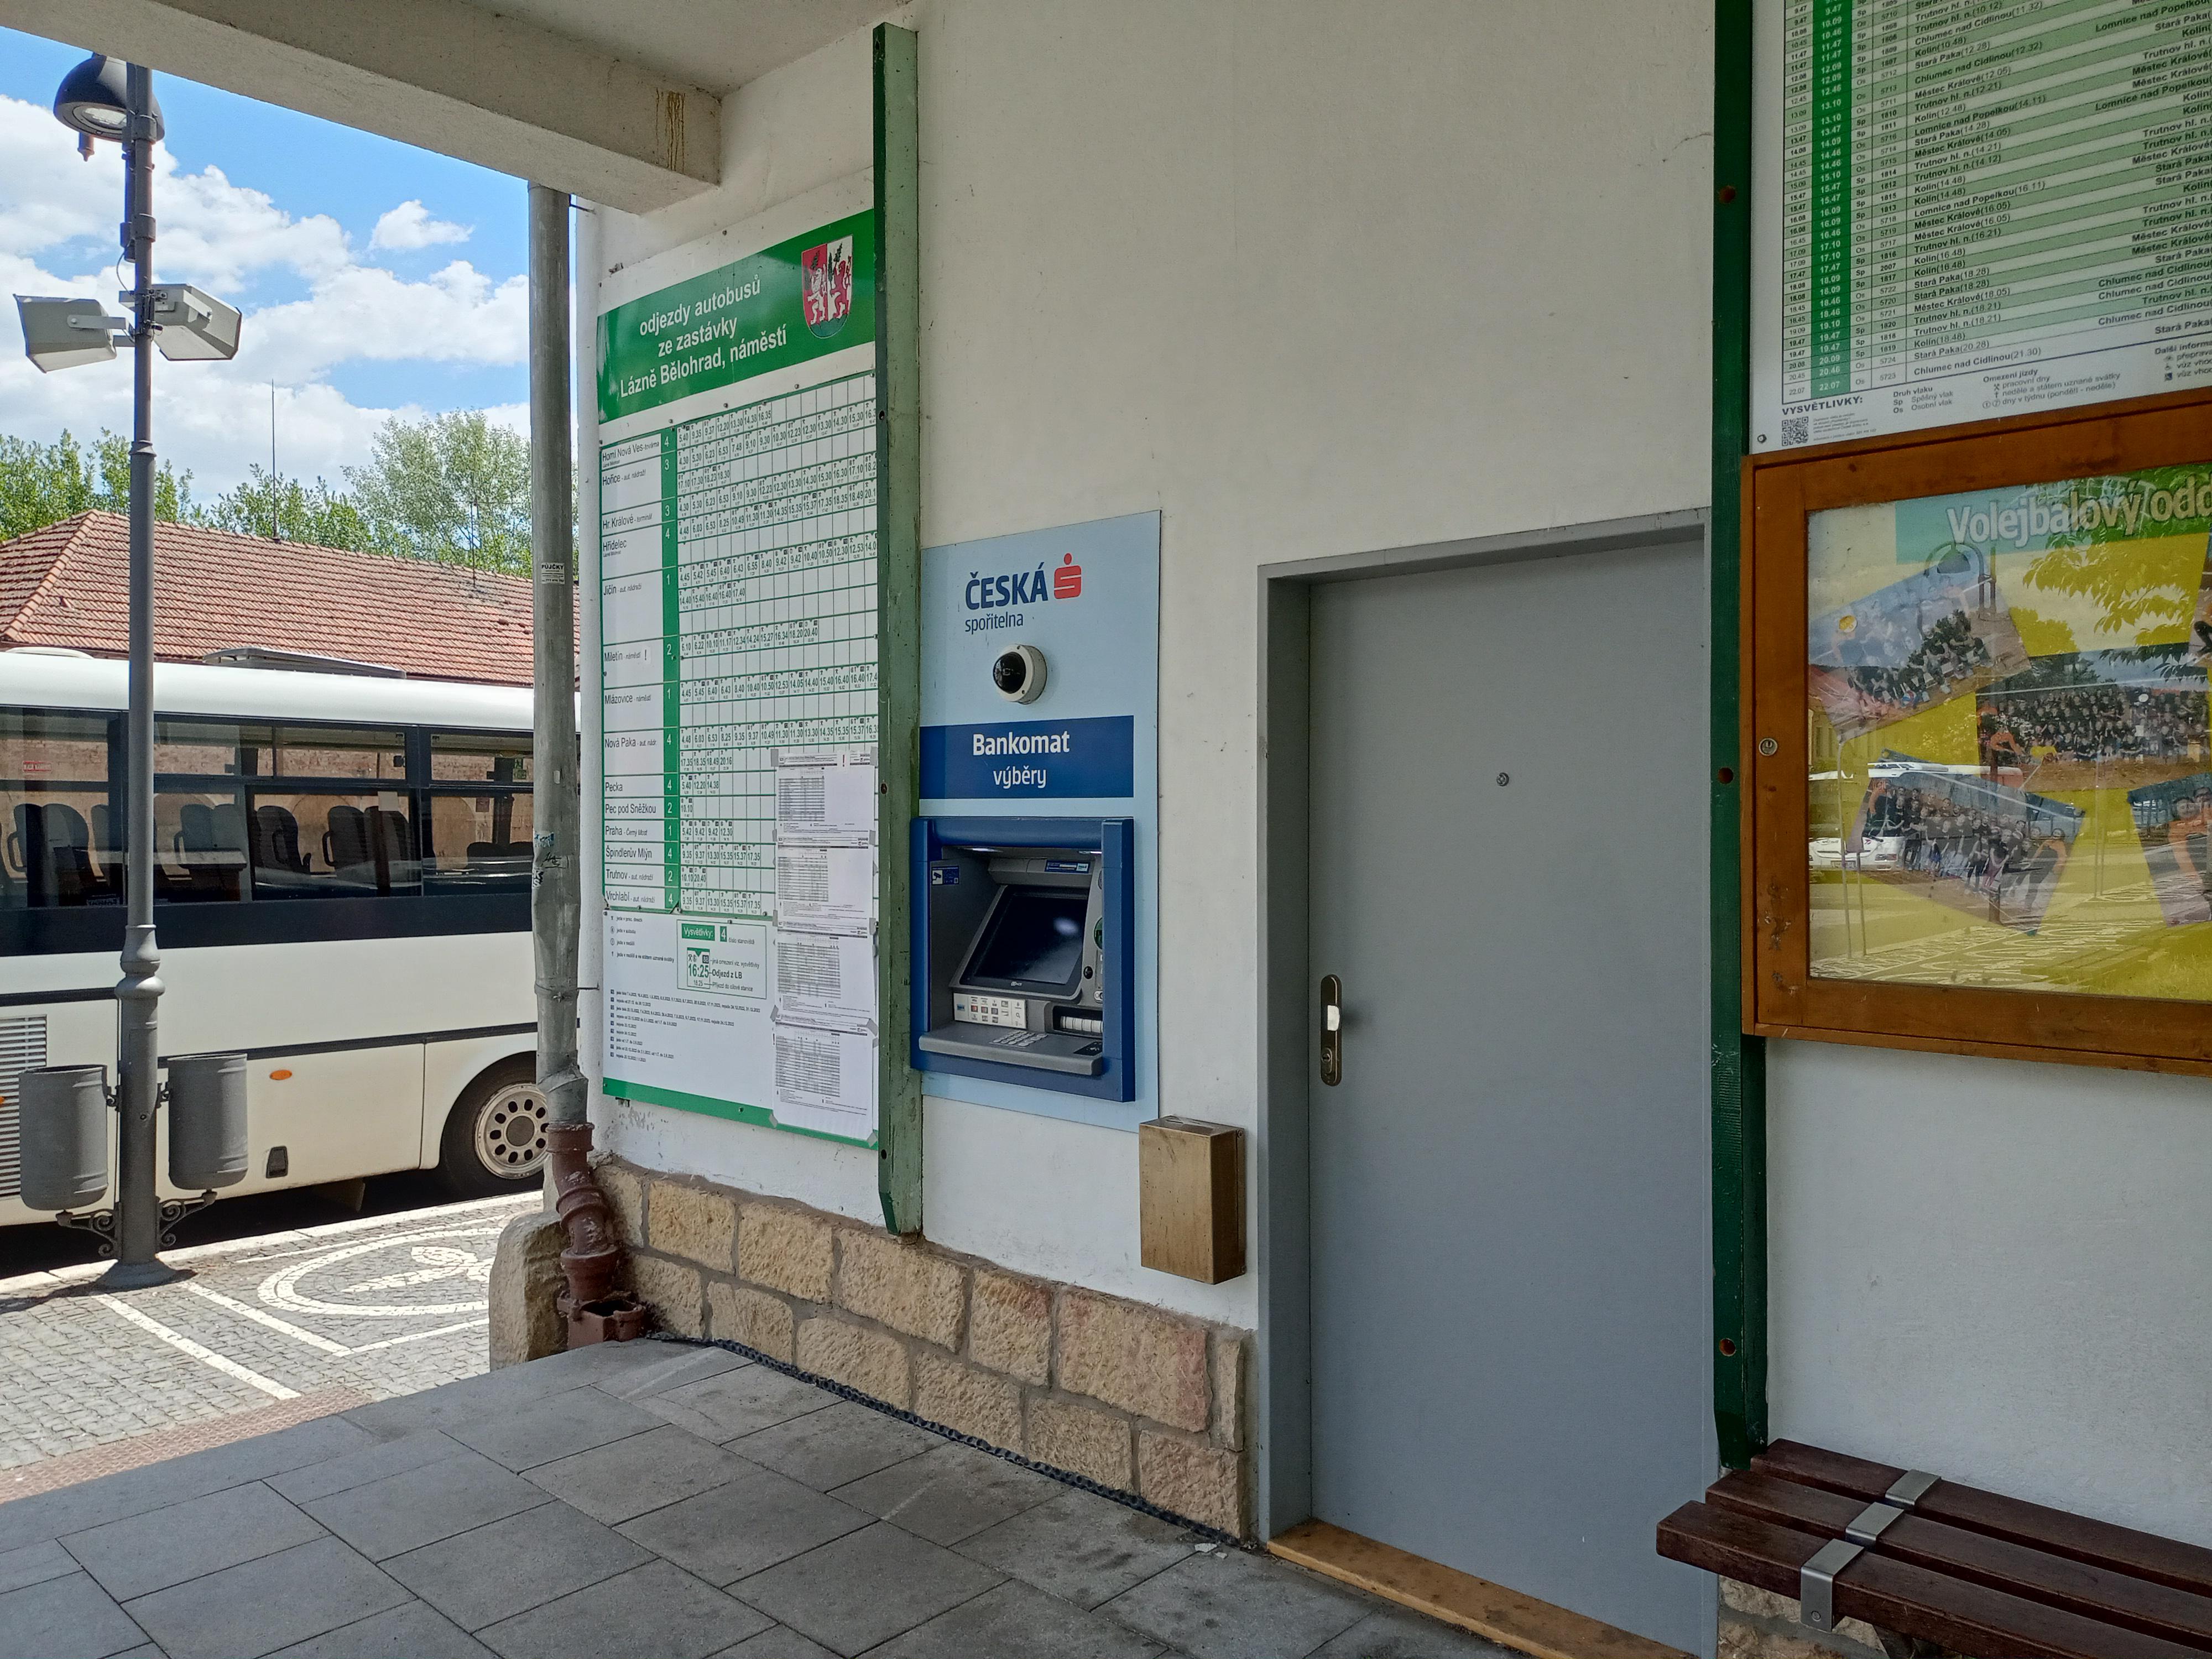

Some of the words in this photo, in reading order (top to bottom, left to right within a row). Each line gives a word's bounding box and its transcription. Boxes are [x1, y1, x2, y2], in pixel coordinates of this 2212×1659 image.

[1915, 121, 1951, 135] Lomnice
[1954, 115, 1970, 126] nad
[1915, 146, 1944, 158] Městec
[1914, 277, 1936, 288] Stará
[640, 304, 690, 336] odjezdy
[695, 274, 760, 316] autobusů
[1914, 301, 1944, 312] Městec
[1914, 313, 1947, 324] Trutnov
[659, 339, 672, 357] ze
[677, 317, 737, 351] zastávky
[1914, 348, 1936, 359] Stará
[620, 369, 656, 398] Lázně
[661, 347, 725, 384] Bělohrad,
[731, 324, 786, 362] náměstí
[1914, 365, 1952, 375] Chlumec
[1954, 360, 1971, 368] nad
[1984, 373, 2017, 383] Omezení
[2020, 369, 2038, 378] jízdy
[2002, 379, 2034, 389] pracovní
[2002, 388, 2027, 397] neděle
[2036, 382, 2062, 392] státem
[2064, 377, 2092, 386] uznané
[2095, 373, 2120, 382] svátky
[2025, 392, 2044, 401] týdnu
[1782, 396, 1863, 415] VYSVĚTLIVKY:
[679, 432, 688, 442] 5.40
[692, 429, 702, 439] 9.35
[705, 426, 714, 435] 9.37
[717, 421, 729, 432] 12.20
[731, 418, 743, 428] 13.30
[759, 411, 771, 421] 16.35
[803, 424, 816, 434] 12.30
[818, 420, 831, 431] 13.30
[833, 416, 847, 426] 14.30
[849, 411, 863, 423] 15.30
[665, 436, 669, 447] 4
[618, 446, 632, 457] Nová
[679, 457, 688, 465] 4.30
[692, 453, 702, 462] 5.30
[705, 450, 715, 459] 6.23
[746, 439, 756, 448] 9.10
[665, 460, 669, 469] 3
[603, 476, 620, 486] Hořice
[665, 505, 670, 516] 3
[1947, 480, 2142, 547] Volejbalový
[665, 529, 670, 539] 4
[603, 539, 627, 551] Hřídelec
[666, 574, 670, 585] 1
[604, 585, 617, 596] Jičín
[965, 562, 1048, 610] ČESKÁ
[965, 612, 1023, 635] spořitelna
[667, 644, 671, 655] 2
[604, 651, 623, 661] Miletín
[805, 678, 818, 687] 14.40
[820, 676, 833, 686] 15.40
[835, 675, 849, 684] 16.40
[851, 673, 865, 682] 16.40
[605, 693, 633, 704] Mlázovice
[667, 688, 671, 699] 1
[605, 738, 619, 748] Nová
[622, 738, 635, 747] Paka
[666, 734, 671, 745] 4
[973, 731, 1070, 757] Bankomat
[993, 766, 1046, 789] výběry
[606, 782, 623, 791] Pecka
[667, 779, 672, 790] 4
[606, 804, 616, 813] Pec
[618, 804, 628, 815] pod
[630, 803, 656, 813] Sněžkou
[667, 802, 672, 813] 2
[606, 826, 622, 835] Praha
[669, 825, 671, 836] 1
[606, 846, 636, 858] Špindlerův
[638, 848, 652, 860] Mlýn
[667, 848, 672, 858] 4
[708, 851, 719, 859] 13.30
[721, 852, 732, 860] 15.35
[748, 852, 760, 860] 17.35
[606, 869, 627, 879] Trutnov
[668, 871, 672, 881] 2
[606, 891, 629, 901] Vrchlabí
[669, 894, 673, 904] 4
[684, 927, 713, 937] Vysvětlivky:
[721, 929, 726, 940] 4
[688, 964, 709, 977] 16:25
[712, 969, 729, 978] Odjezd
